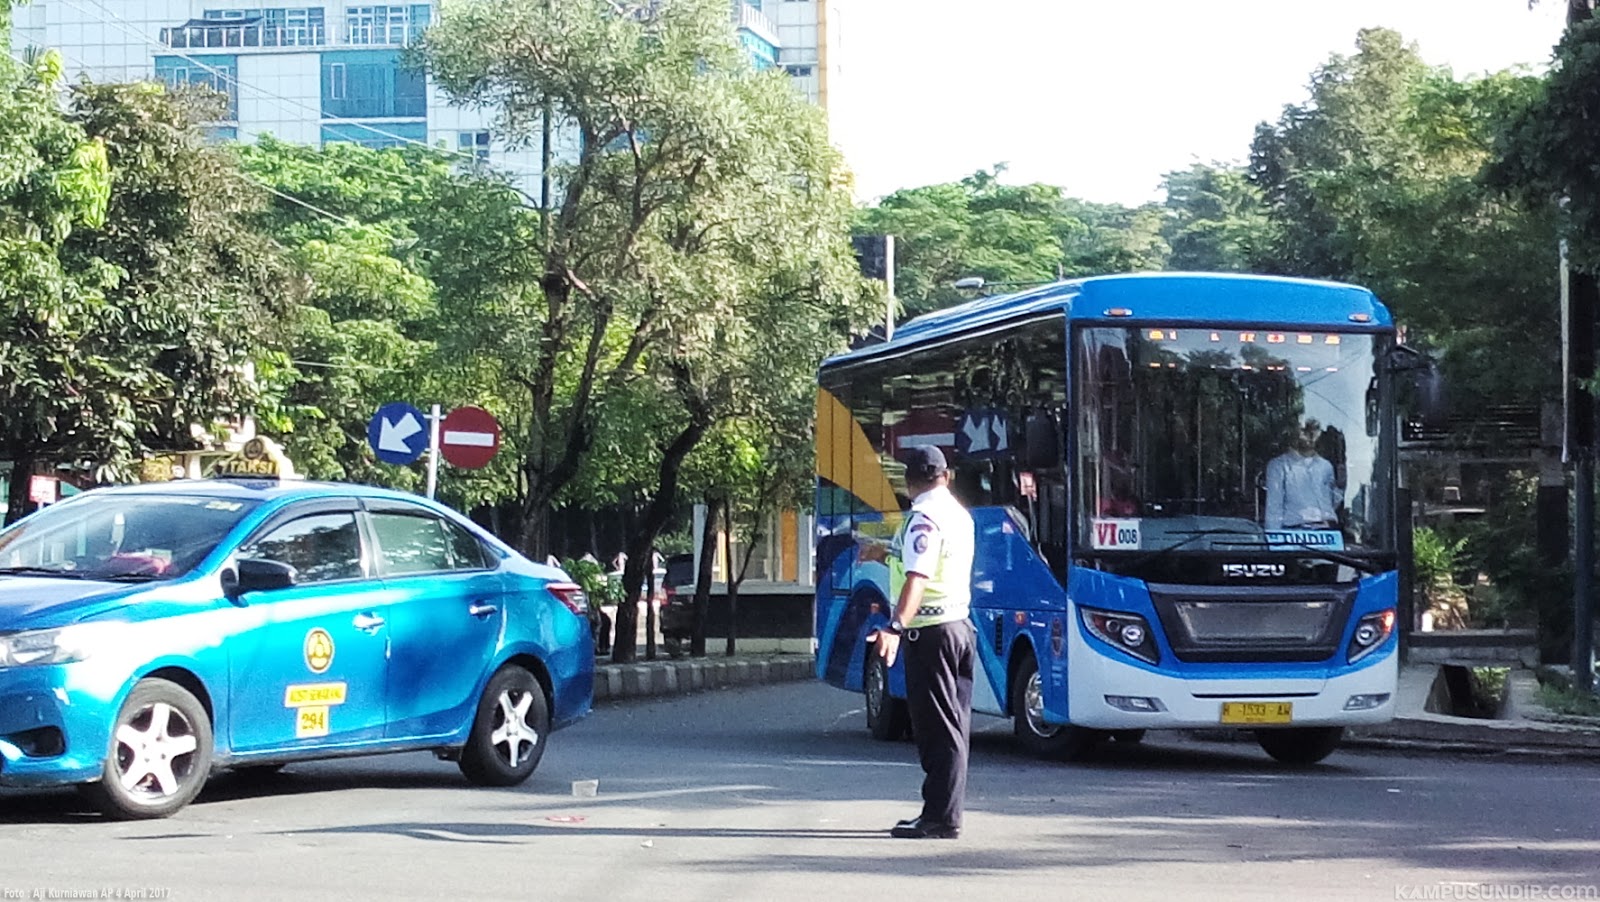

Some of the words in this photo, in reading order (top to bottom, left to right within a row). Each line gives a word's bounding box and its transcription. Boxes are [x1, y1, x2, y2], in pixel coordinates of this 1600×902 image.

[230, 461, 273, 474] TAKSI
[1095, 523, 1117, 546] VI
[1118, 529, 1138, 544] 008
[1222, 564, 1286, 577] ISUZU
